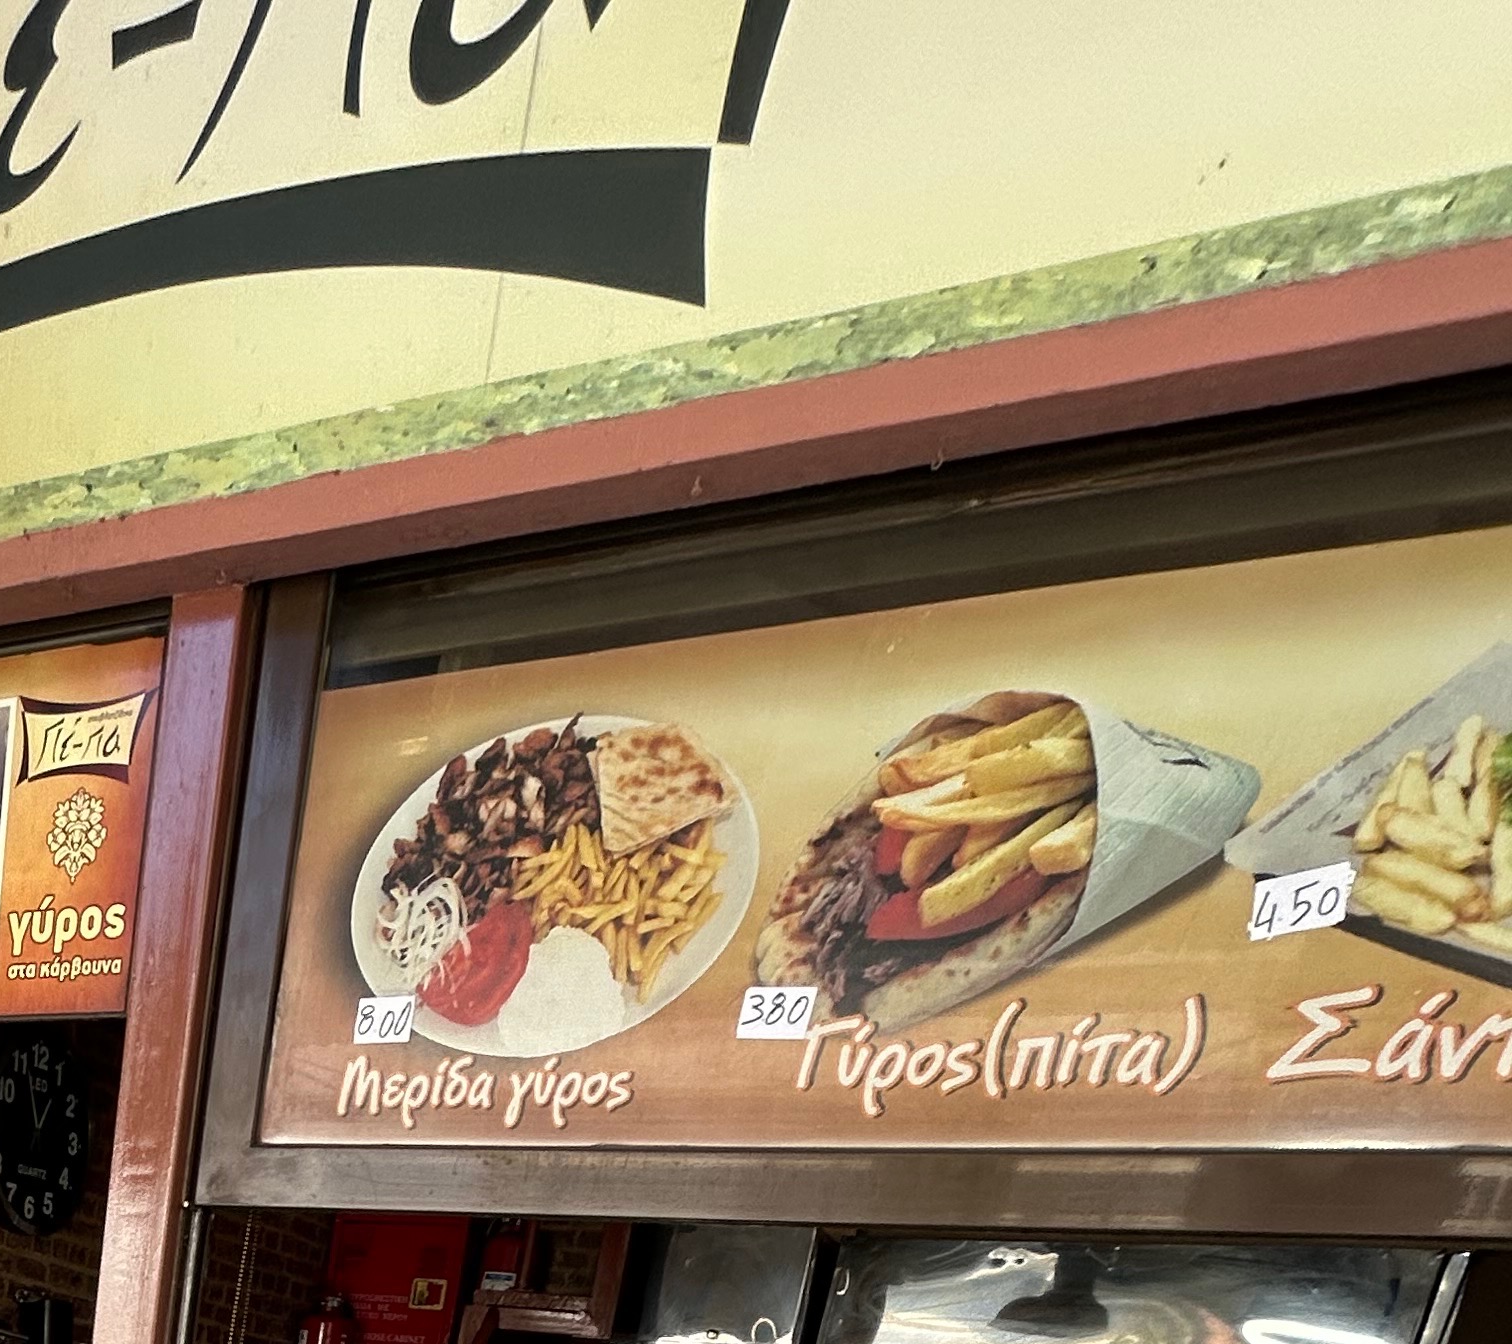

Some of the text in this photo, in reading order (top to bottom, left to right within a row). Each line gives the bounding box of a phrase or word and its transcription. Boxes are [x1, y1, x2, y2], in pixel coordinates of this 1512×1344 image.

[8, 896, 127, 956] γύρος
[7, 956, 122, 981] στα κάρβουνα
[12, 1049, 28, 1076] 11
[32, 1042, 49, 1071] 12
[798, 996, 1205, 1117] Γύρος(πίτα)
[0, 1076, 16, 1103] 10
[337, 1055, 633, 1129] Μερίδα γύρος
[65, 1093, 76, 1119] 2
[68, 1132, 78, 1156] 3
[58, 1166, 70, 1191] 4
[6, 1181, 18, 1203] 7
[42, 1191, 54, 1216] 5
[23, 1195, 35, 1220] 6
